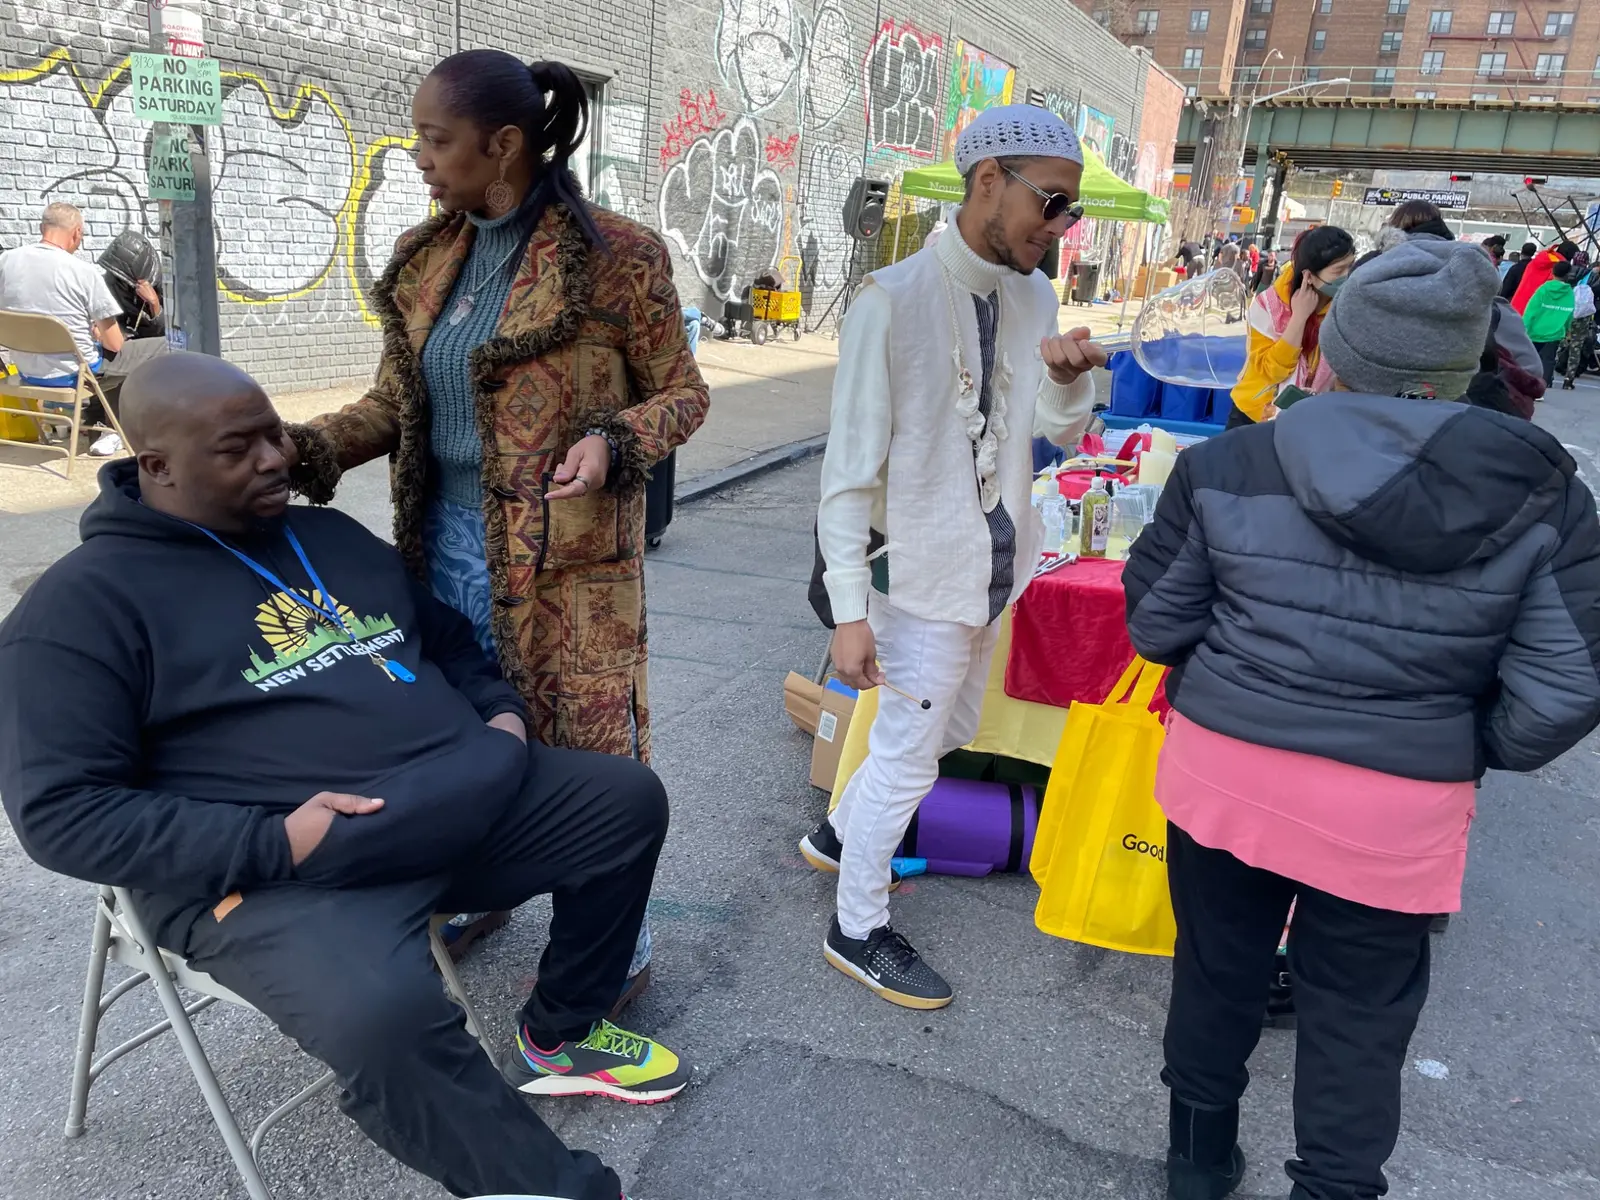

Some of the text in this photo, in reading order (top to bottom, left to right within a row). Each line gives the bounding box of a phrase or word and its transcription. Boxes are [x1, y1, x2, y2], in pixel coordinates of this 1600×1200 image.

[163, 58, 187, 75] NO
[139, 75, 213, 96] PARKING
[138, 96, 216, 115] SATURDAY
[1402, 192, 1431, 200] PUBLIC
[1431, 193, 1466, 202] PARKING
[254, 628, 405, 692] NEW SETTLEMENT
[1122, 833, 1164, 863] Good
